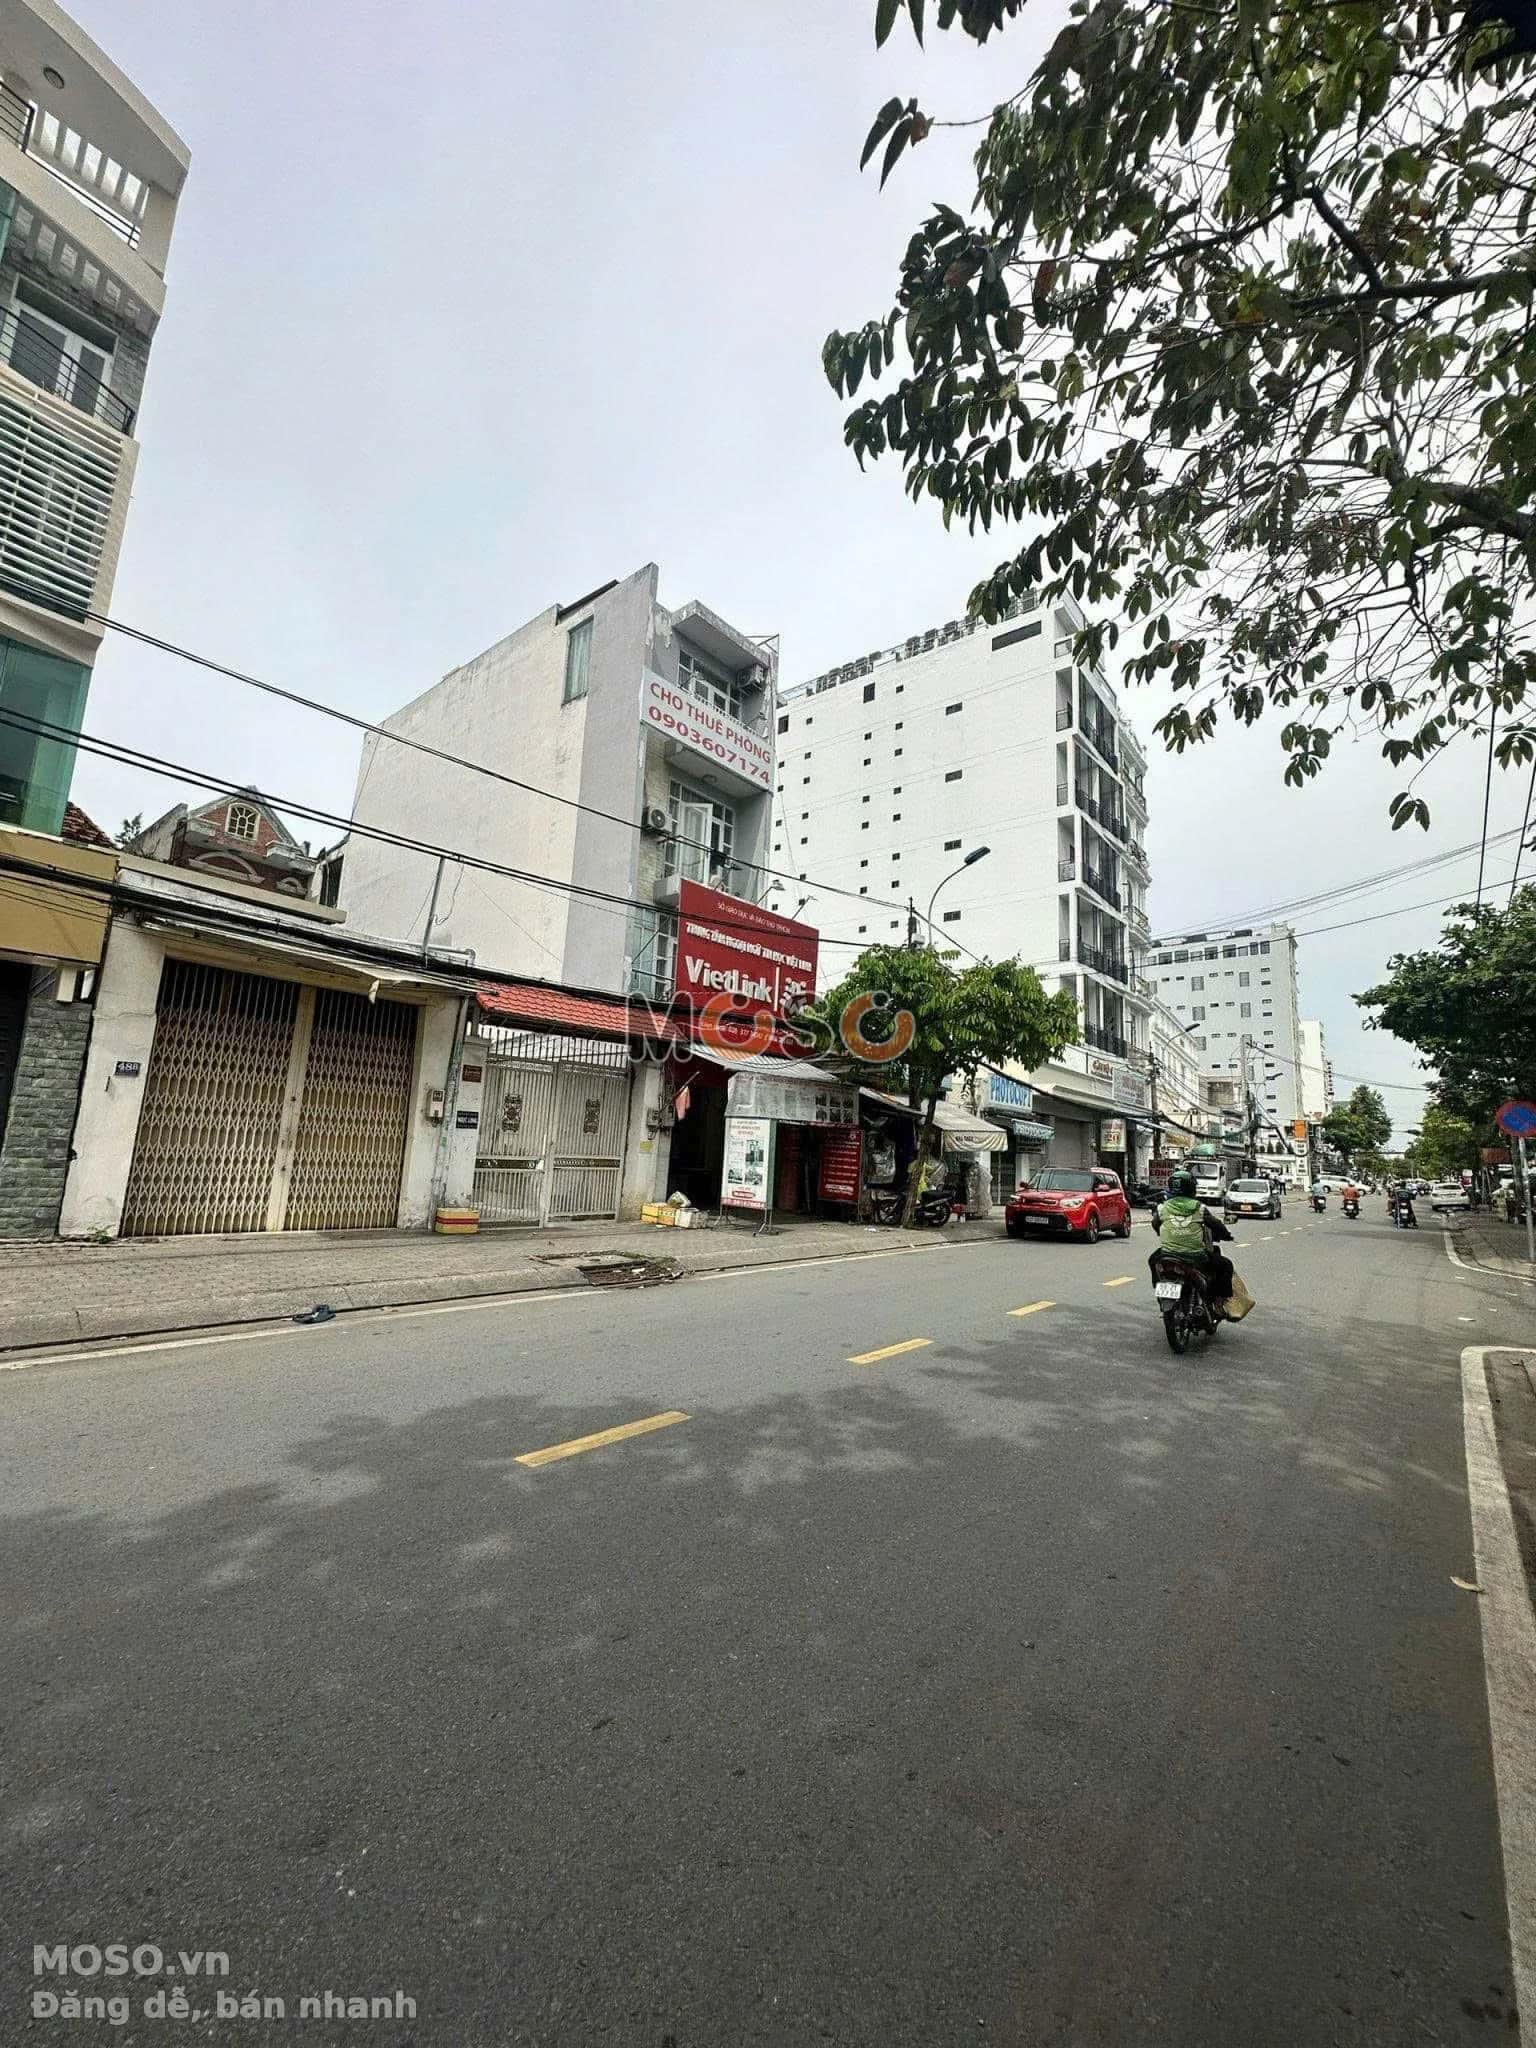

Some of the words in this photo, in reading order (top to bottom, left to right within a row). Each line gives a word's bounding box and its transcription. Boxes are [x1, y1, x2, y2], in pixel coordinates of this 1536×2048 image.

[648, 705, 769, 783] 0903607174
[650, 681, 684, 711] CHO
[686, 702, 723, 735] THUÊ
[726, 726, 771, 764] PHÒNG
